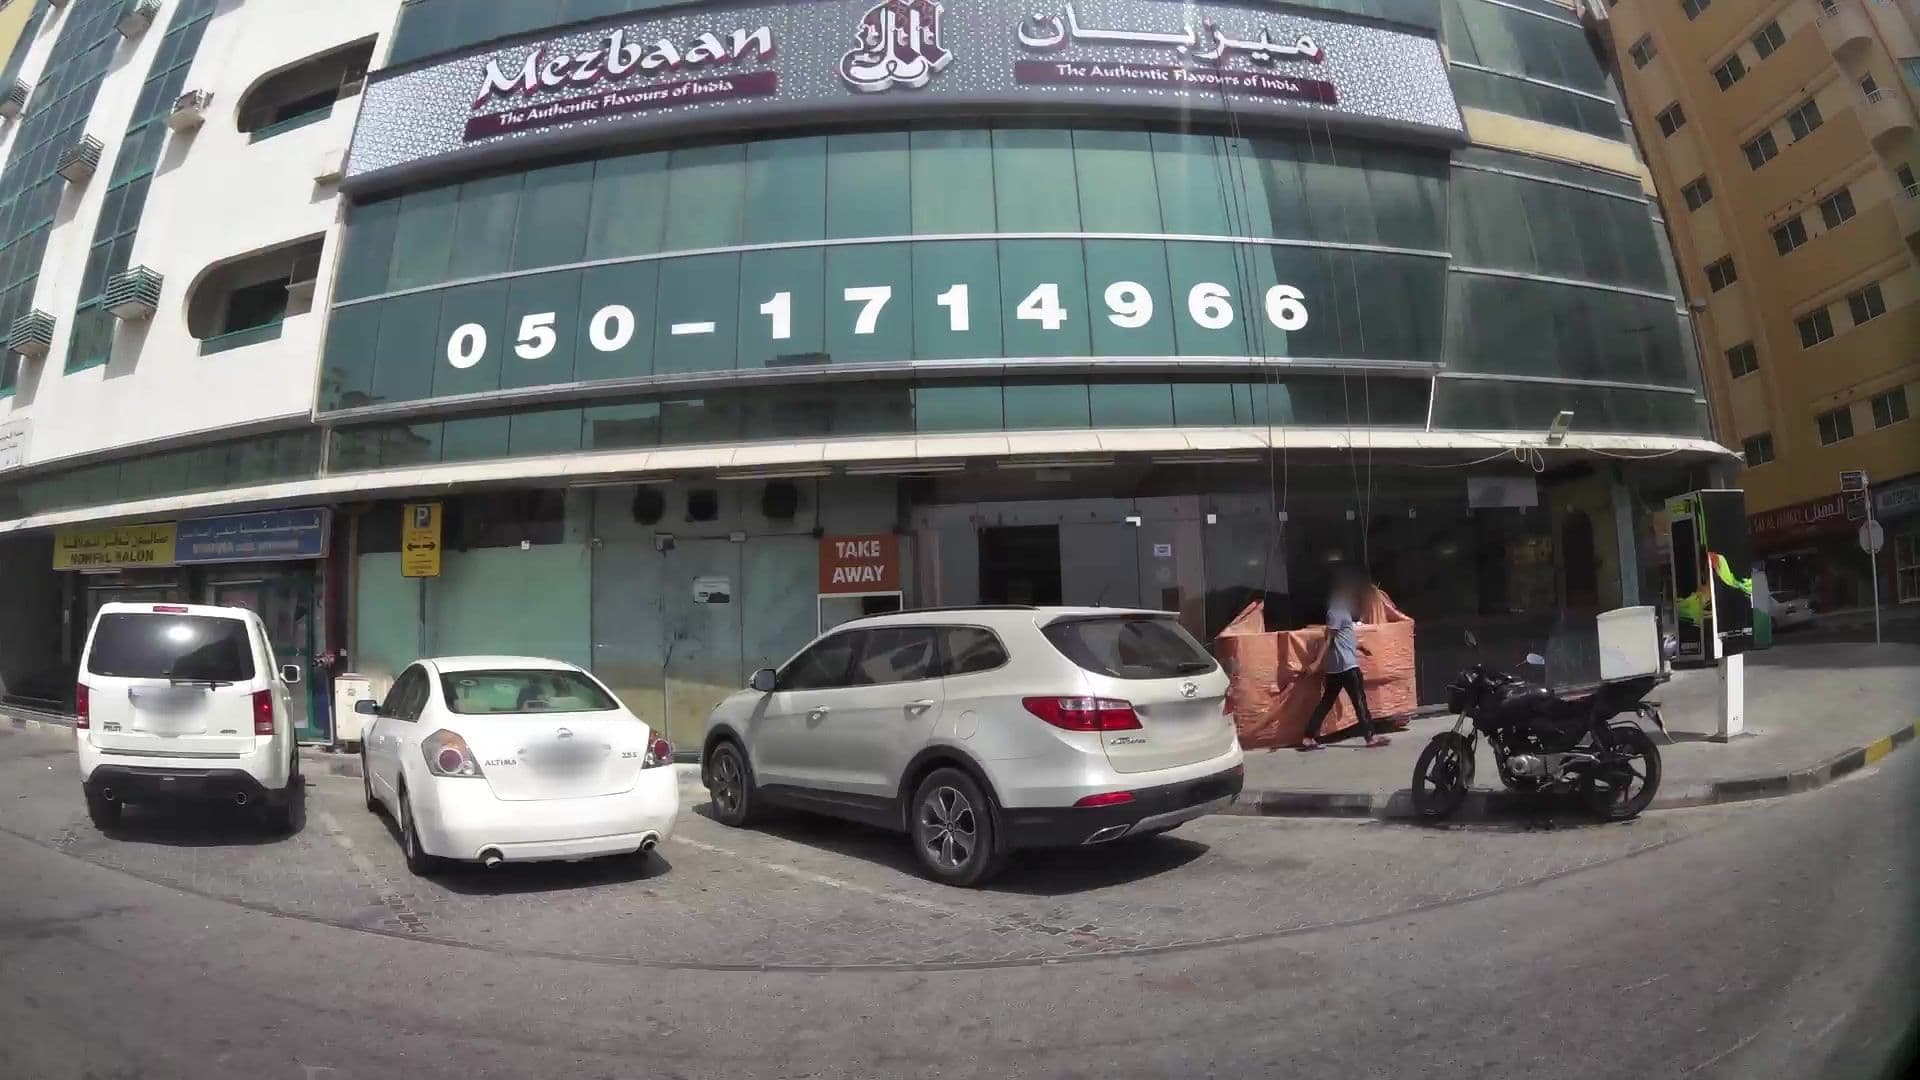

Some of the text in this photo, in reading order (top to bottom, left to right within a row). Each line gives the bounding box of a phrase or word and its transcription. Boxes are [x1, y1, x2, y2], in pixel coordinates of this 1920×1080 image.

[1017, 2, 1321, 60] ميزبان
[473, 24, 775, 108] Mezbaan
[1056, 64, 1300, 93] The Authentic Flavours of India
[499, 79, 734, 126] The Authentic Flavours of India
[416, 506, 430, 528] P
[835, 540, 881, 560] TAKE
[832, 564, 885, 584] AWAY
[484, 759, 517, 767] ALTIMA
